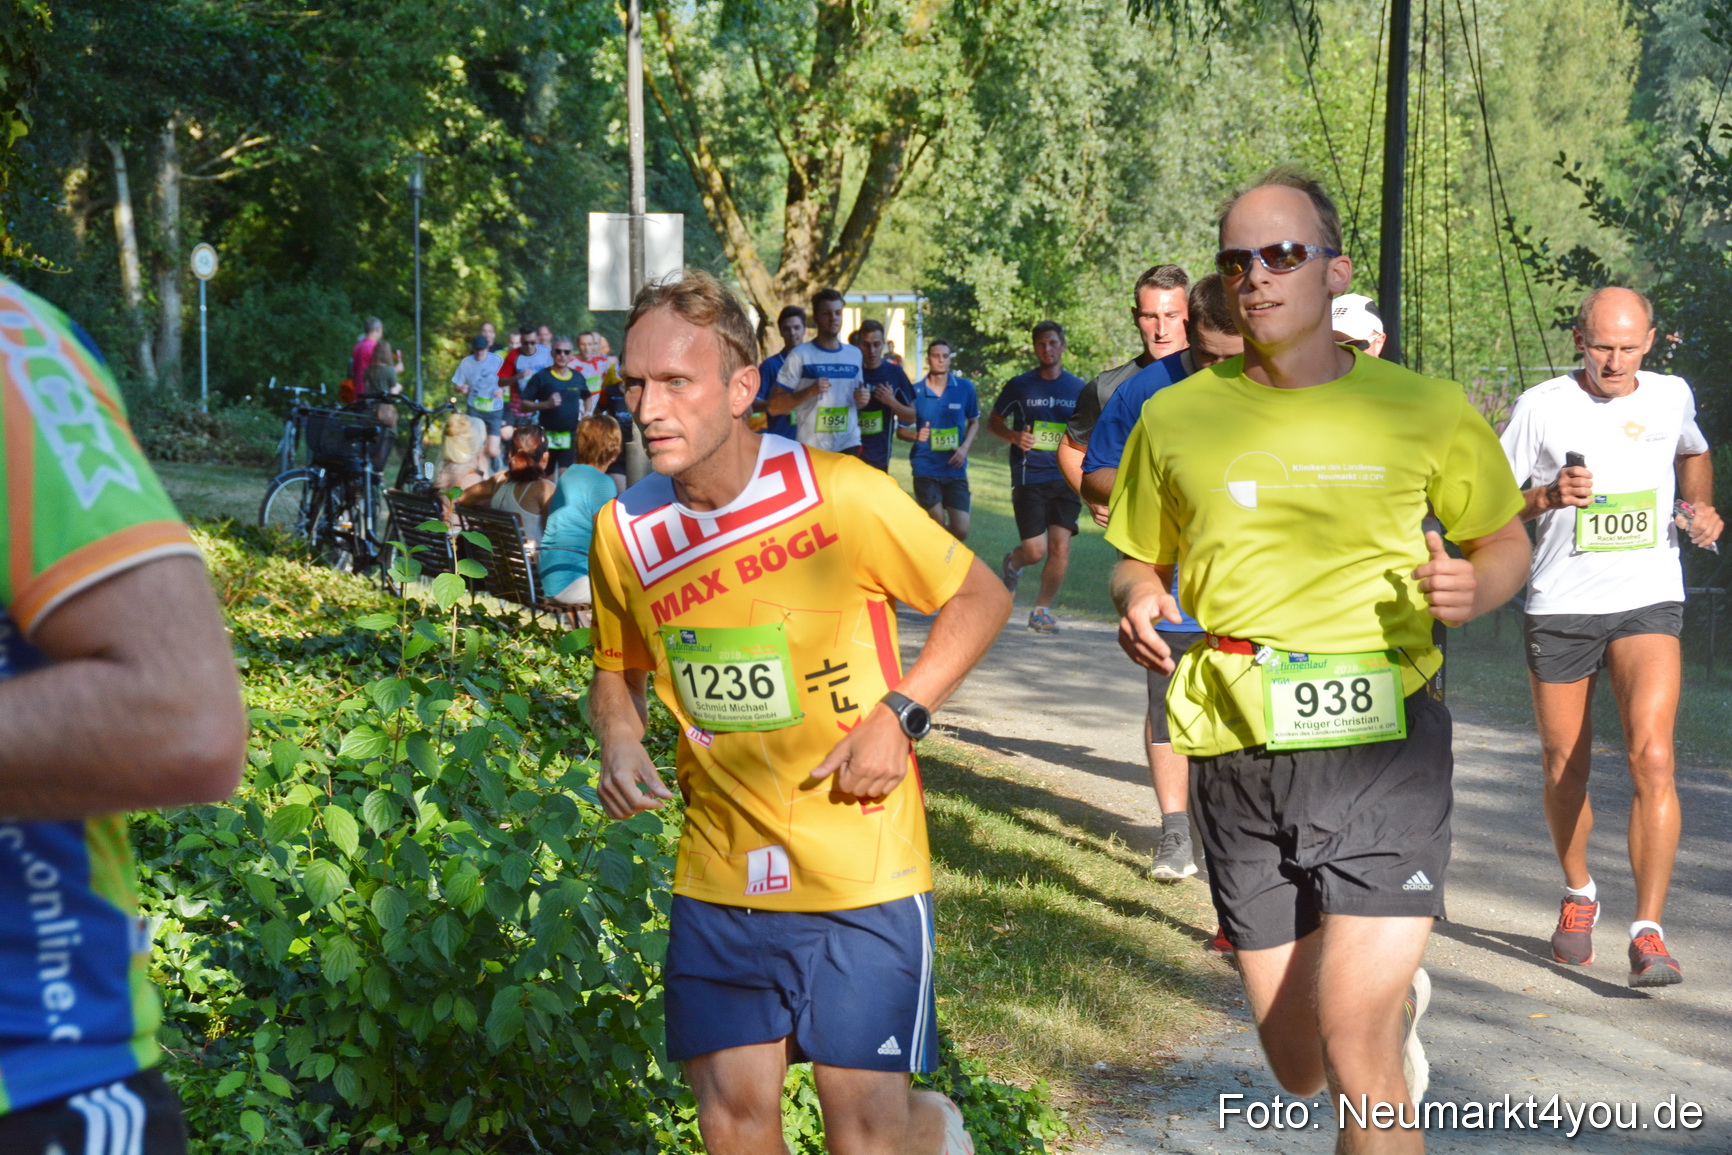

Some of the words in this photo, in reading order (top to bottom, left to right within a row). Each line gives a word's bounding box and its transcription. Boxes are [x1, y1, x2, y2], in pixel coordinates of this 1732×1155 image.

[1027, 399, 1048, 407] EURO
[822, 415, 845, 426] 1954
[1292, 464, 1326, 472] Kliniken
[1589, 511, 1648, 535] 1008
[650, 567, 729, 626] MAX
[735, 522, 839, 584] BÖGL
[1280, 660, 1327, 671] firmenlauf
[682, 663, 775, 701] 1236
[1294, 677, 1374, 718] 938
[695, 701, 728, 713] Schmid
[729, 702, 769, 713] Michael
[717, 712, 753, 721] Bauservice
[1294, 720, 1331, 731] Krüger
[1333, 715, 1380, 728] Christian
